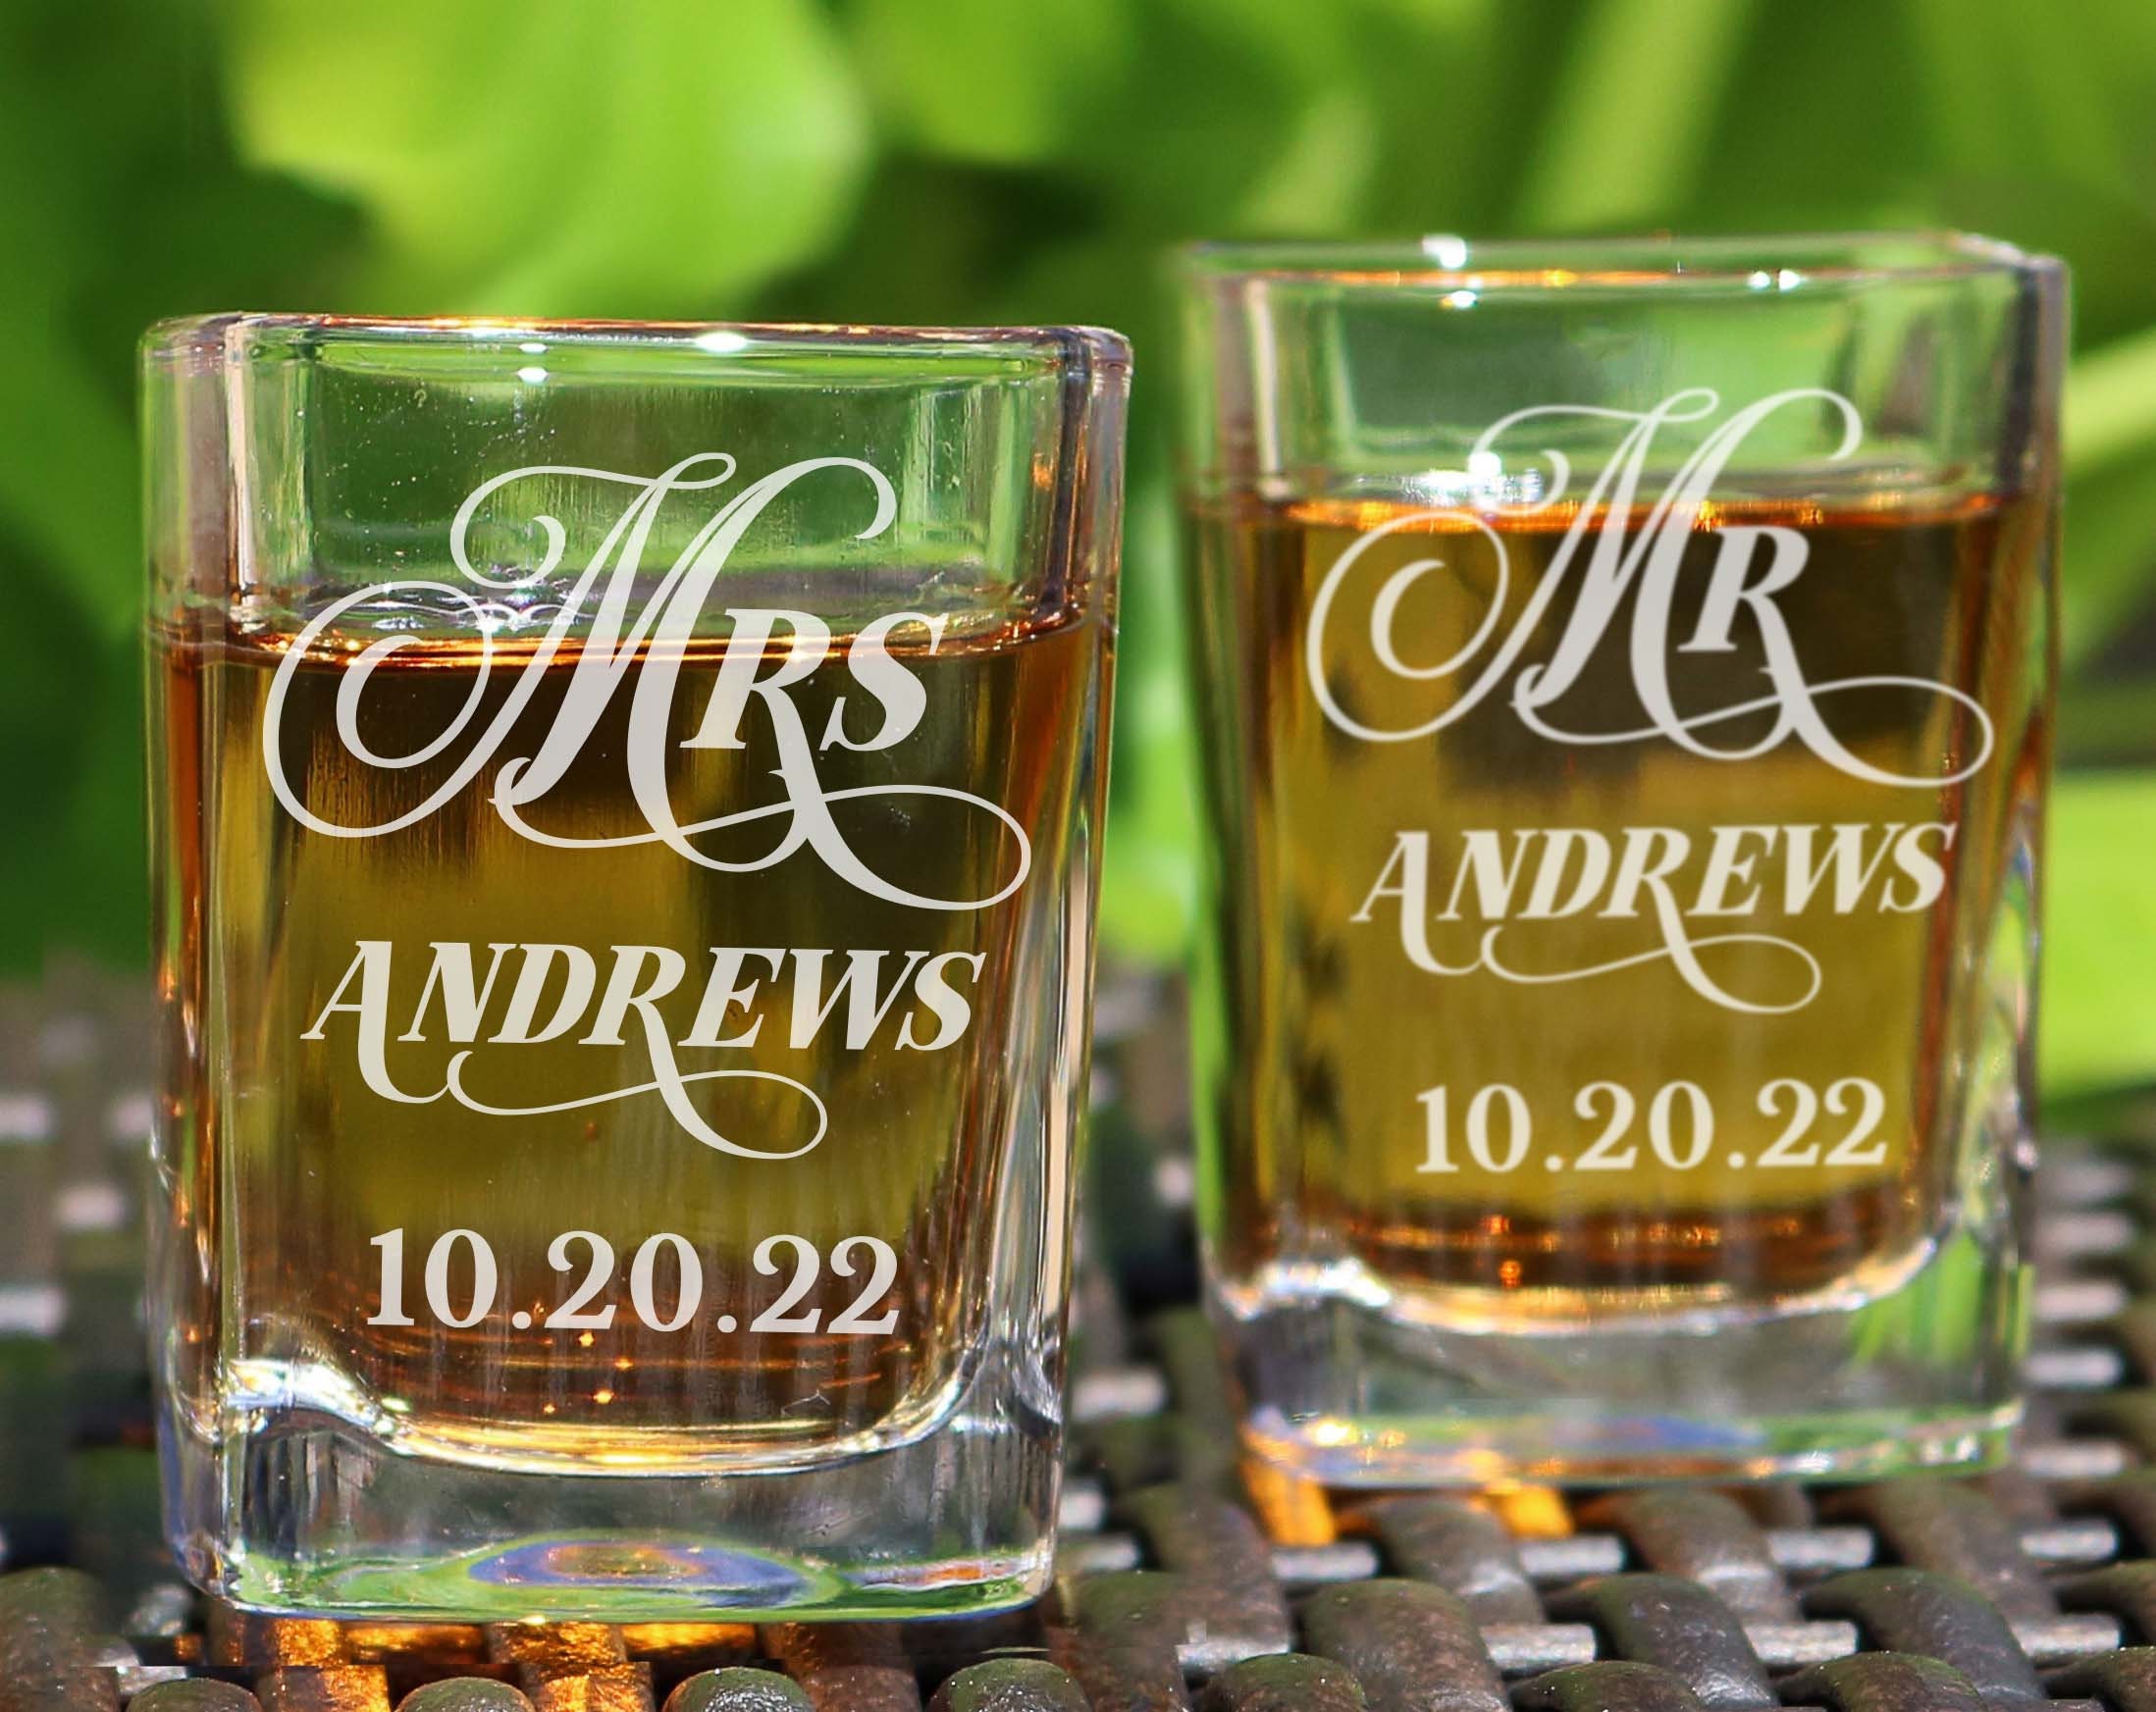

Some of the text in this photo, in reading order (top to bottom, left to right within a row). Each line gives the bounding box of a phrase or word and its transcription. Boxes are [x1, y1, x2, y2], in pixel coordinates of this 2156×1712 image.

[1352, 821, 1957, 1013] ANDREWS
[303, 940, 986, 1160] ANDREWS
[1415, 1077, 1886, 1173] 10.20.22
[367, 1227, 901, 1335] 10.20.22
